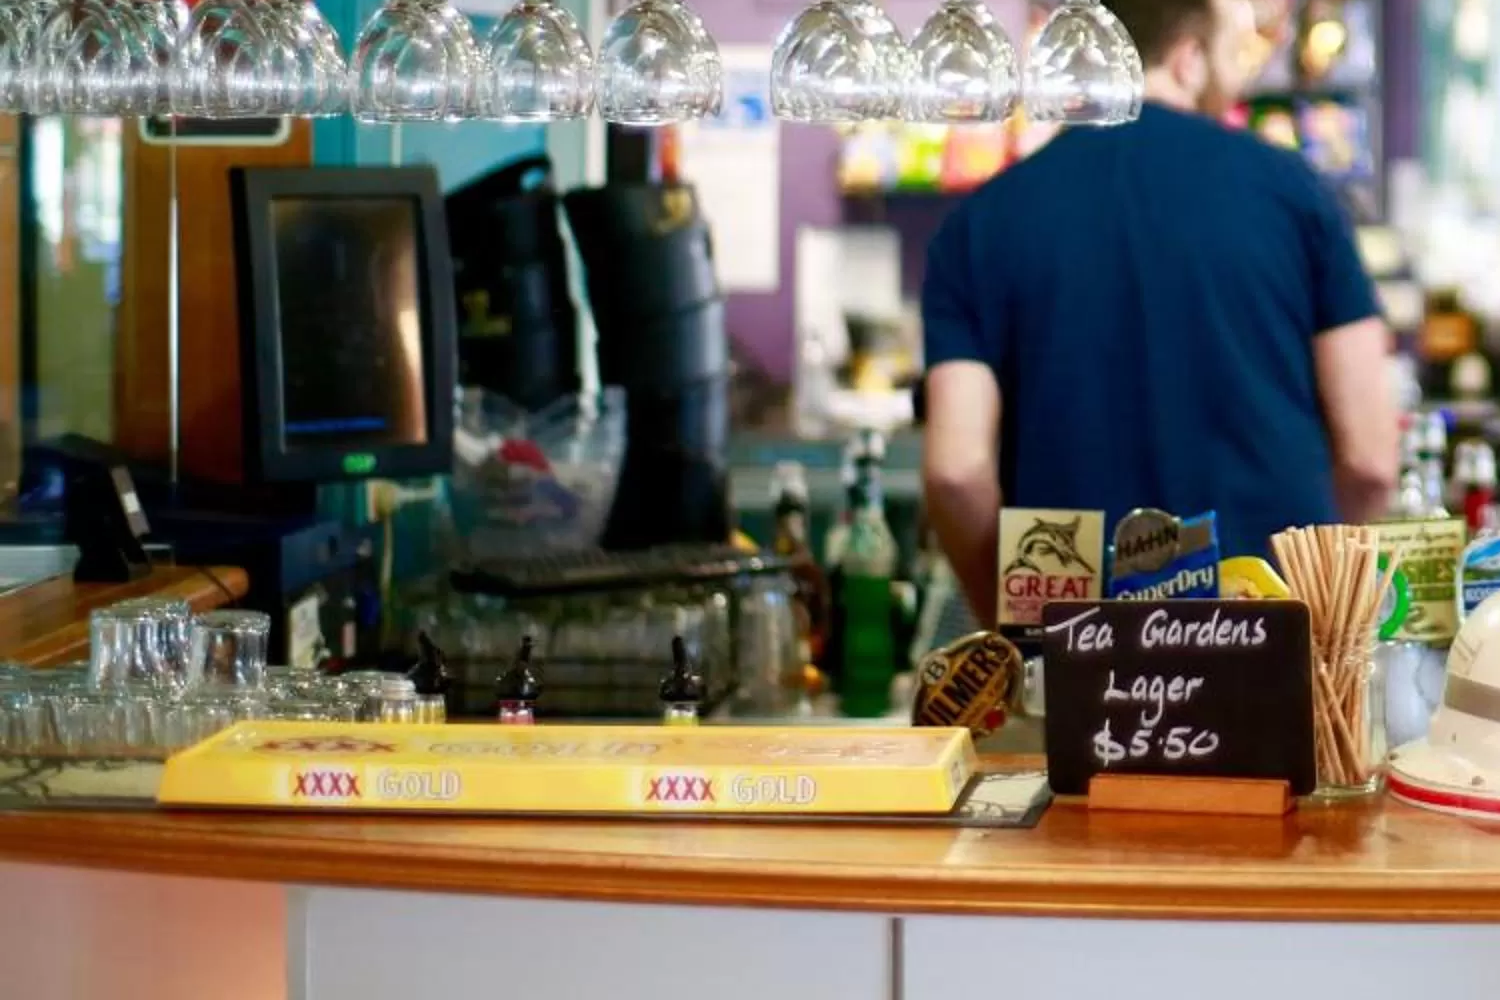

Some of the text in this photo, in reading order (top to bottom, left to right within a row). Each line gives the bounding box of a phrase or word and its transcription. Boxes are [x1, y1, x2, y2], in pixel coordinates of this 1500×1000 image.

[1117, 523, 1179, 560] HAHN
[1003, 575, 1093, 598] GREAT
[1045, 606, 1114, 653] Tea
[1141, 609, 1268, 649] Gardens
[920, 638, 1011, 726] ULMERS
[1103, 669, 1205, 727] Lager
[1092, 719, 1220, 768] $5.50
[292, 769, 462, 800] XXXX GOLD
[645, 774, 818, 805] XXXX GOLD
